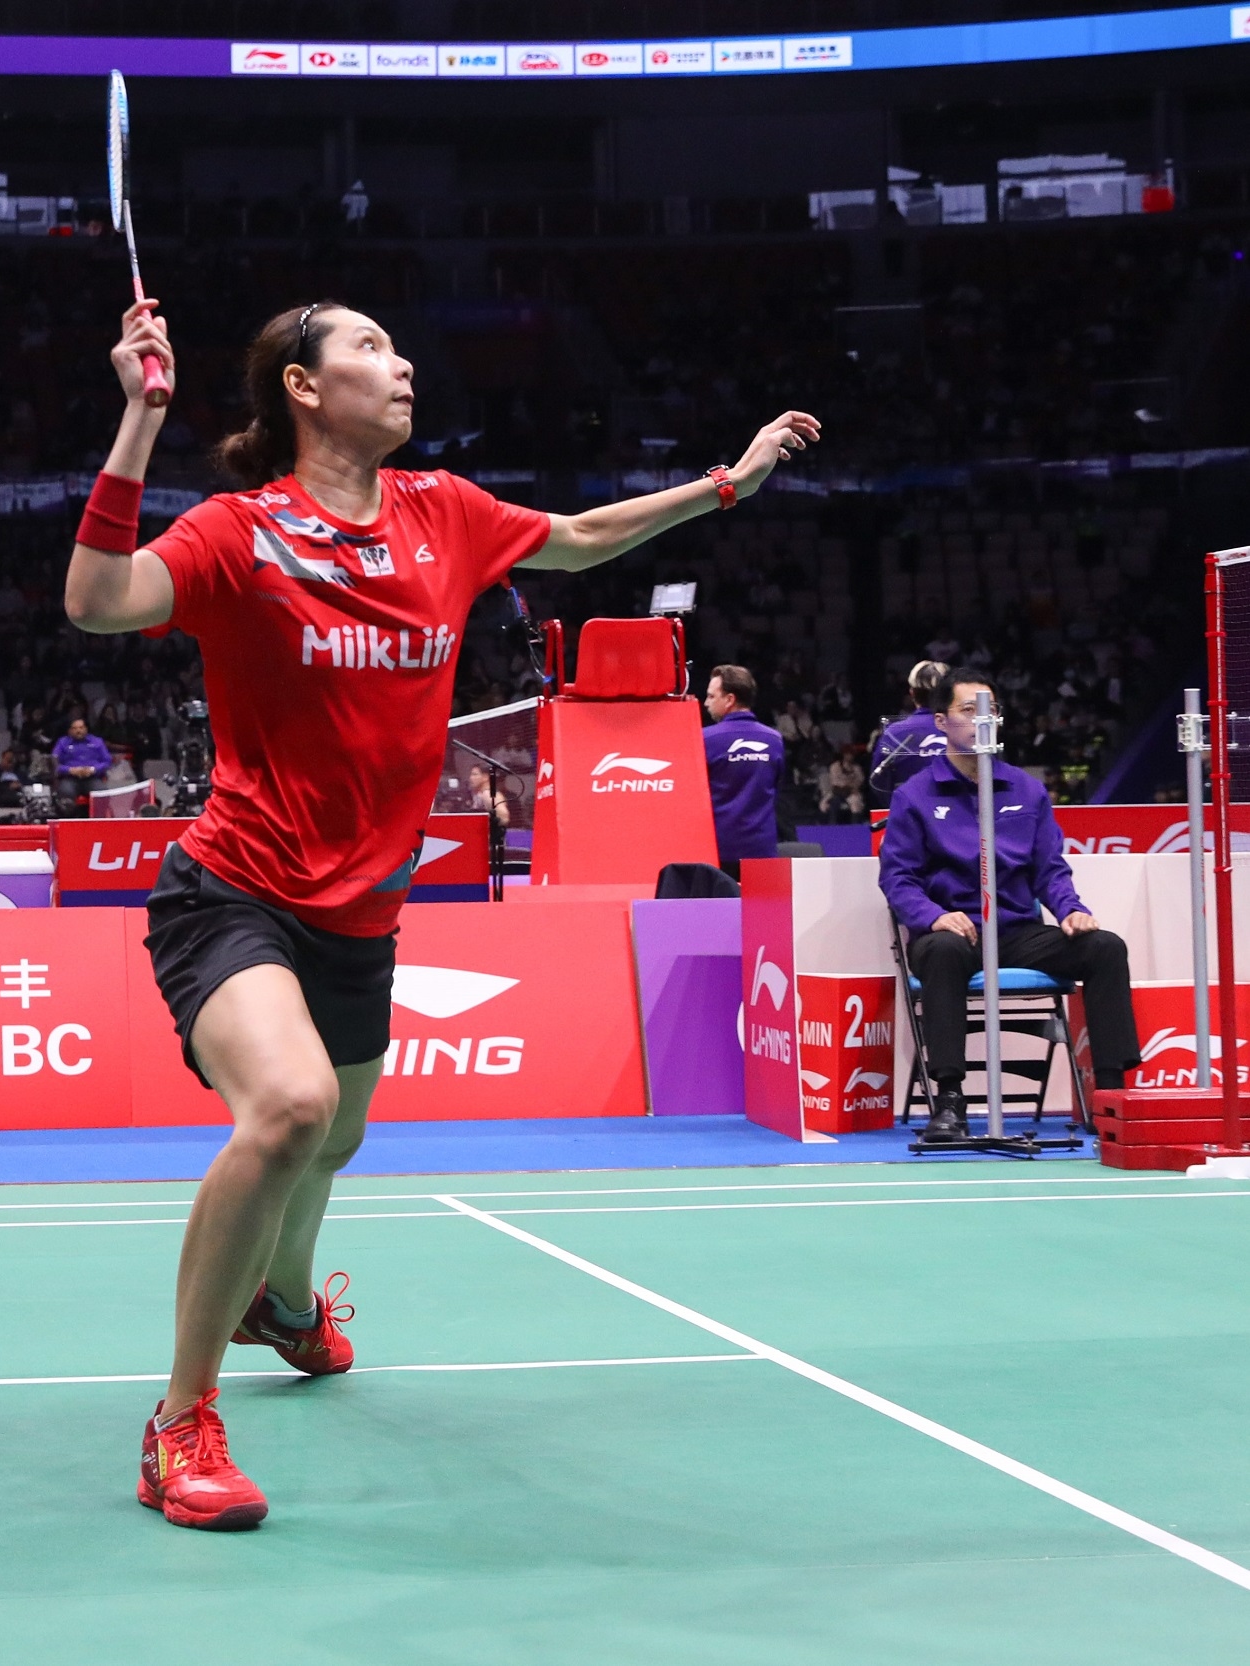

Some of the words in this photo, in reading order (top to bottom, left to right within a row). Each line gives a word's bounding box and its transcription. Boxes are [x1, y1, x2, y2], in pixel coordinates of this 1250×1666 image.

[376, 55, 429, 67] foundit
[728, 754, 769, 762] LI-NING
[592, 779, 674, 792] LI-NING
[844, 995, 863, 1048] 2
[864, 1021, 891, 1046] MIN
[803, 1020, 832, 1047] MIN
[751, 1023, 791, 1065] LI-NING
[843, 1095, 889, 1112] LI-NING
